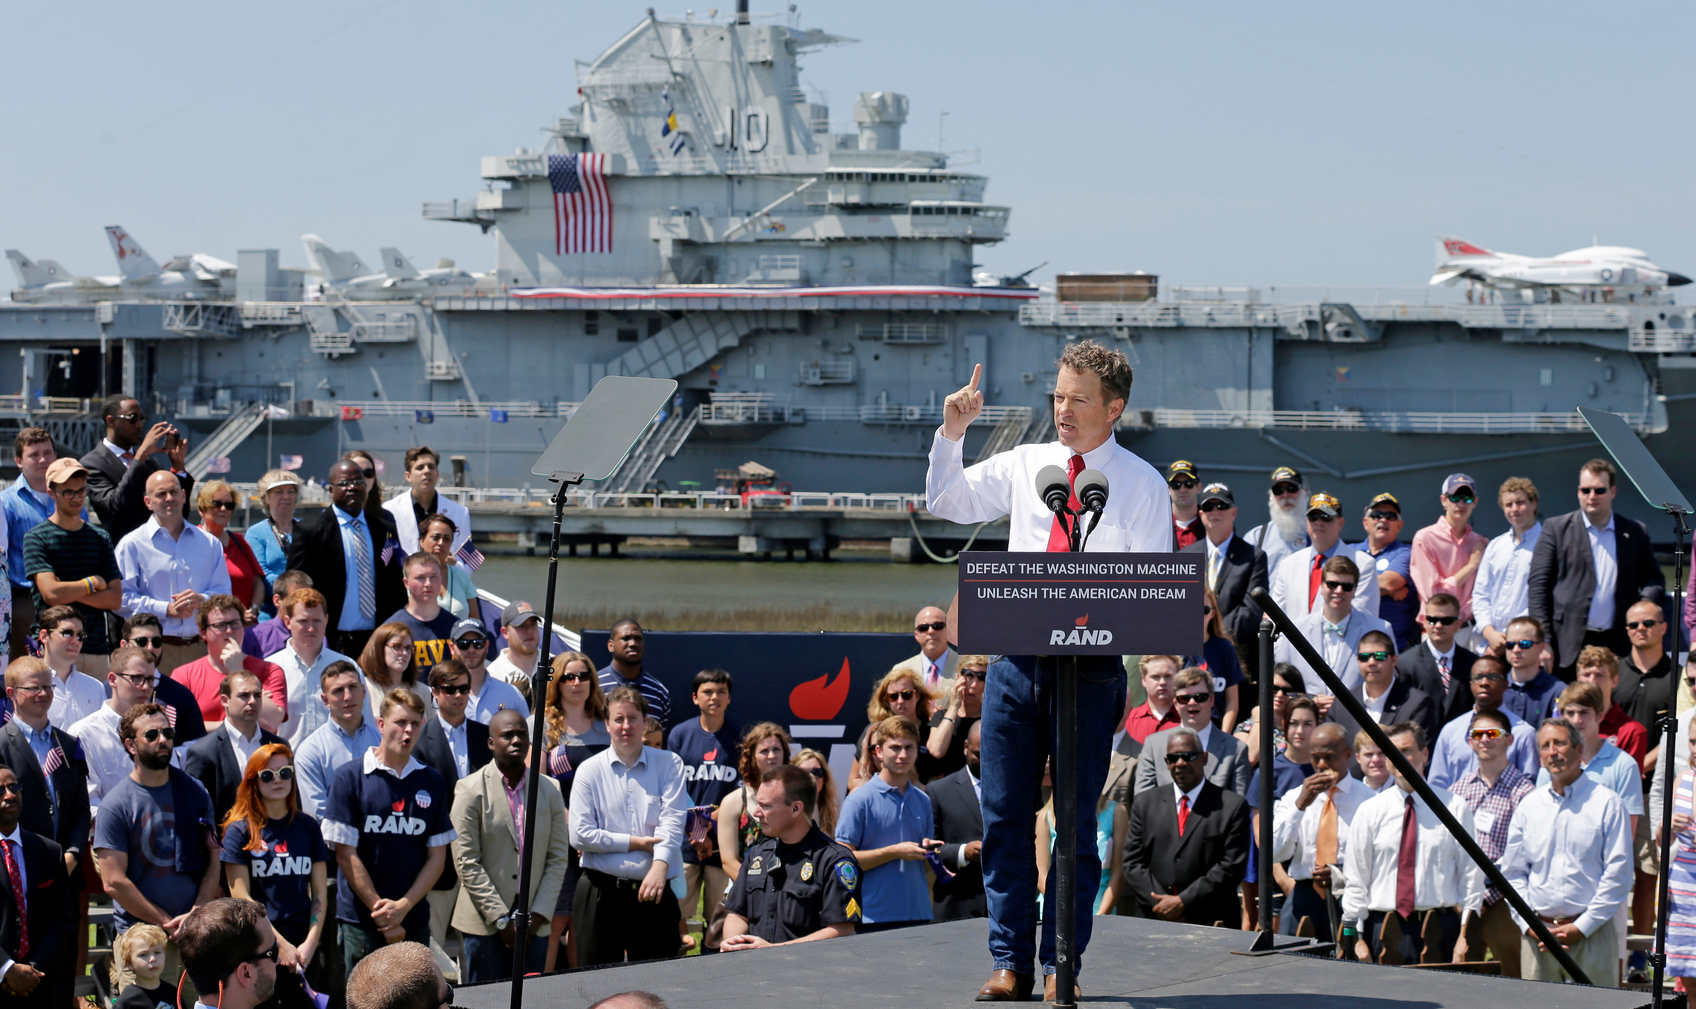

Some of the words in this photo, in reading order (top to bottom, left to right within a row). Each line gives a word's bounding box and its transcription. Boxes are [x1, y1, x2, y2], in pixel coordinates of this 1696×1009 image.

[966, 562, 1016, 575] DEFEAT
[1017, 562, 1045, 575] THE
[1046, 563, 1134, 576] WASHINGTON
[1137, 563, 1197, 576] MACHINE
[977, 587, 1038, 600] UNLEASH
[1040, 587, 1067, 600] THE
[1069, 587, 1137, 600] AMERICAN
[1140, 588, 1186, 600] DREAM
[1049, 629, 1113, 646] RAND
[412, 639, 457, 667] AV
[684, 764, 737, 782] RAND
[363, 814, 427, 836] RAND
[251, 856, 312, 878] RAND
